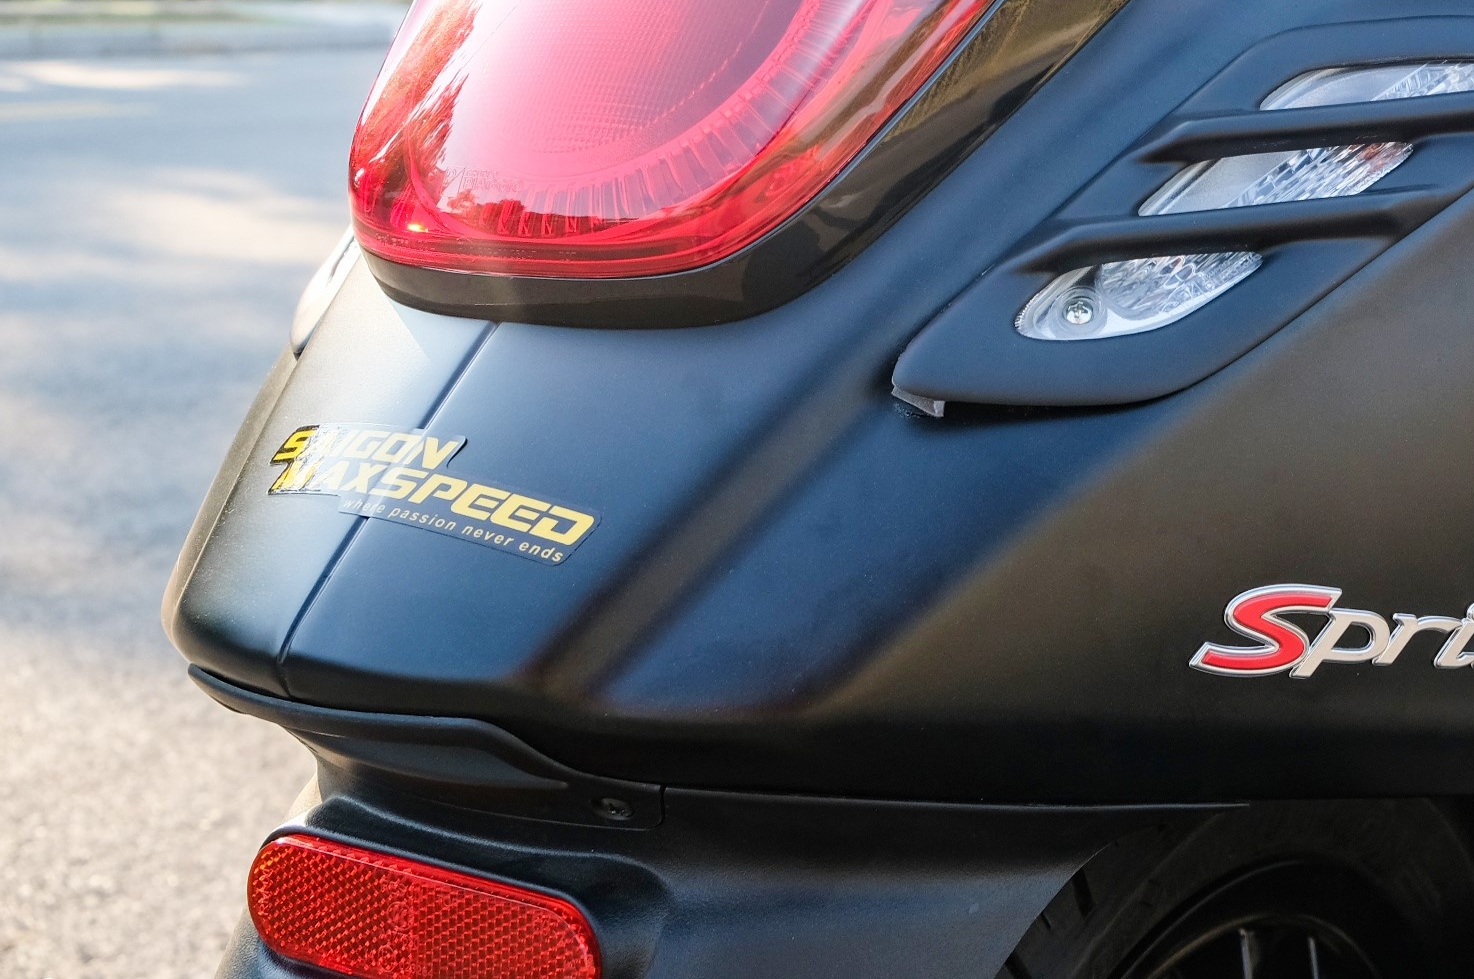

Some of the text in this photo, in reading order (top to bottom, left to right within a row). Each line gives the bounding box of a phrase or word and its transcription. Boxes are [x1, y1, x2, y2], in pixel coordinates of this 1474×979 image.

[343, 498, 564, 563] where passion never ends
